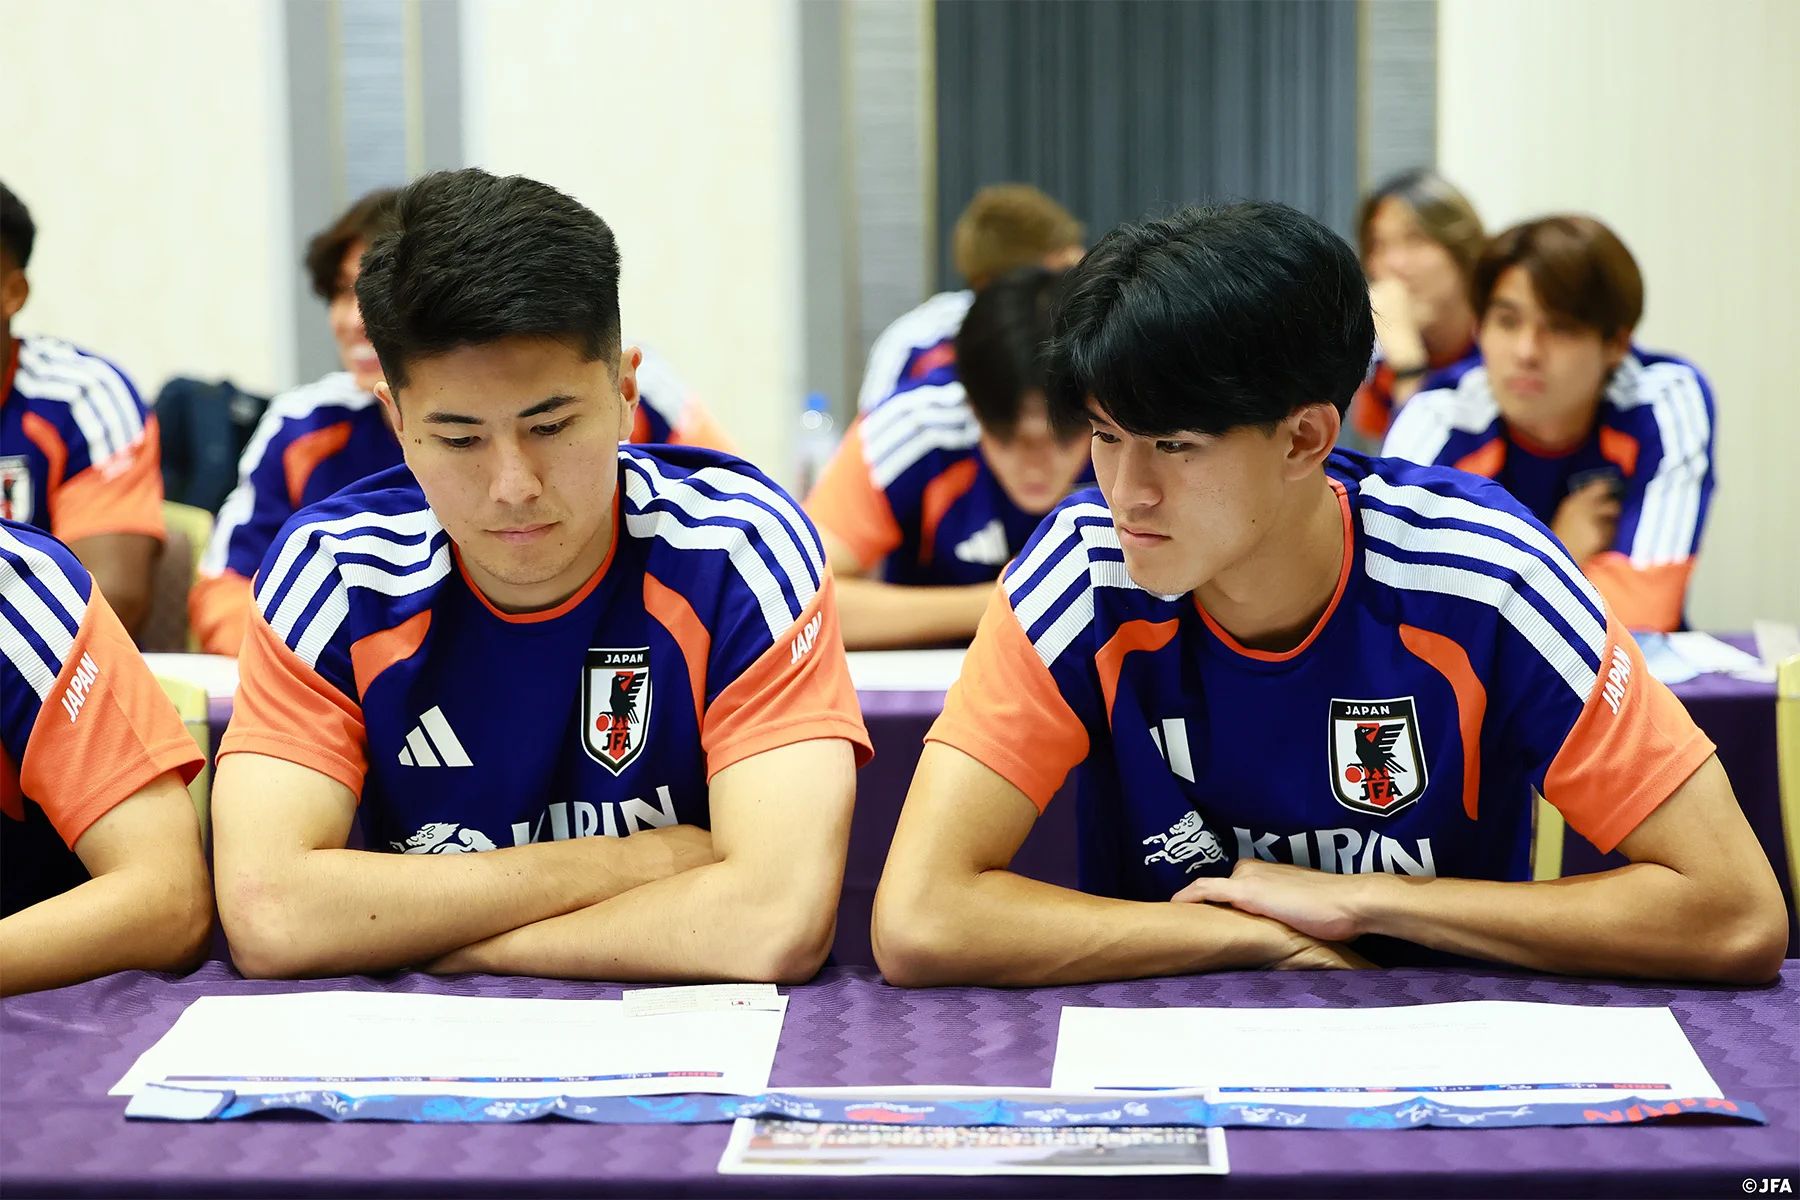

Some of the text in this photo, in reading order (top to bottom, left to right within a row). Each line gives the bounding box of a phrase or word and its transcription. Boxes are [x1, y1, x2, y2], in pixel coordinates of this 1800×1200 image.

[603, 653, 644, 664] JAPAN
[61, 651, 99, 723] JAPAN
[1602, 645, 1631, 715] JAPAN
[1345, 705, 1390, 716] JAPAN
[602, 732, 632, 751] JFA
[1359, 781, 1403, 801] JFA
[1233, 826, 1436, 878] KIRIN
